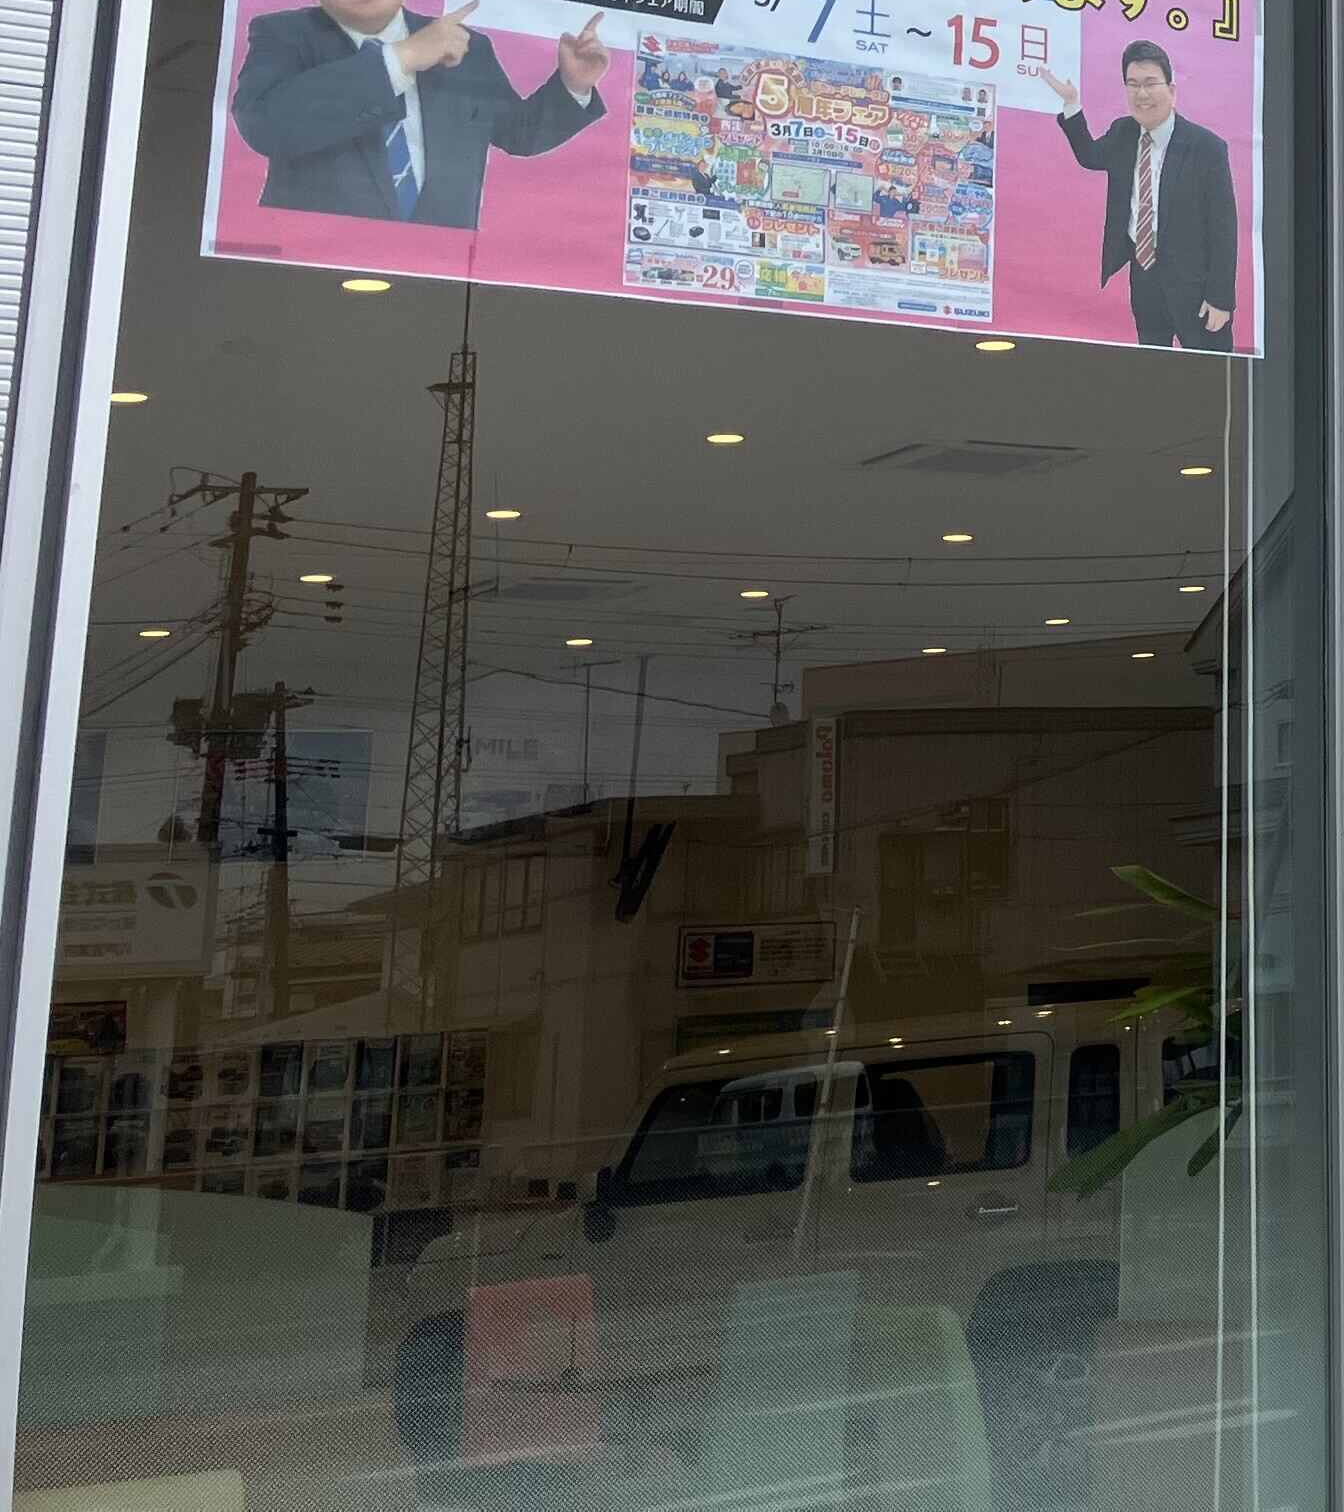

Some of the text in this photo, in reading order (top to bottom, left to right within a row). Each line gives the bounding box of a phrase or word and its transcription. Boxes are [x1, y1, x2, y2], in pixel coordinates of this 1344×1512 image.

[854, 39, 889, 55] SAT
[1016, 63, 1042, 77] SU
[953, 307, 991, 319] SUZUKI
